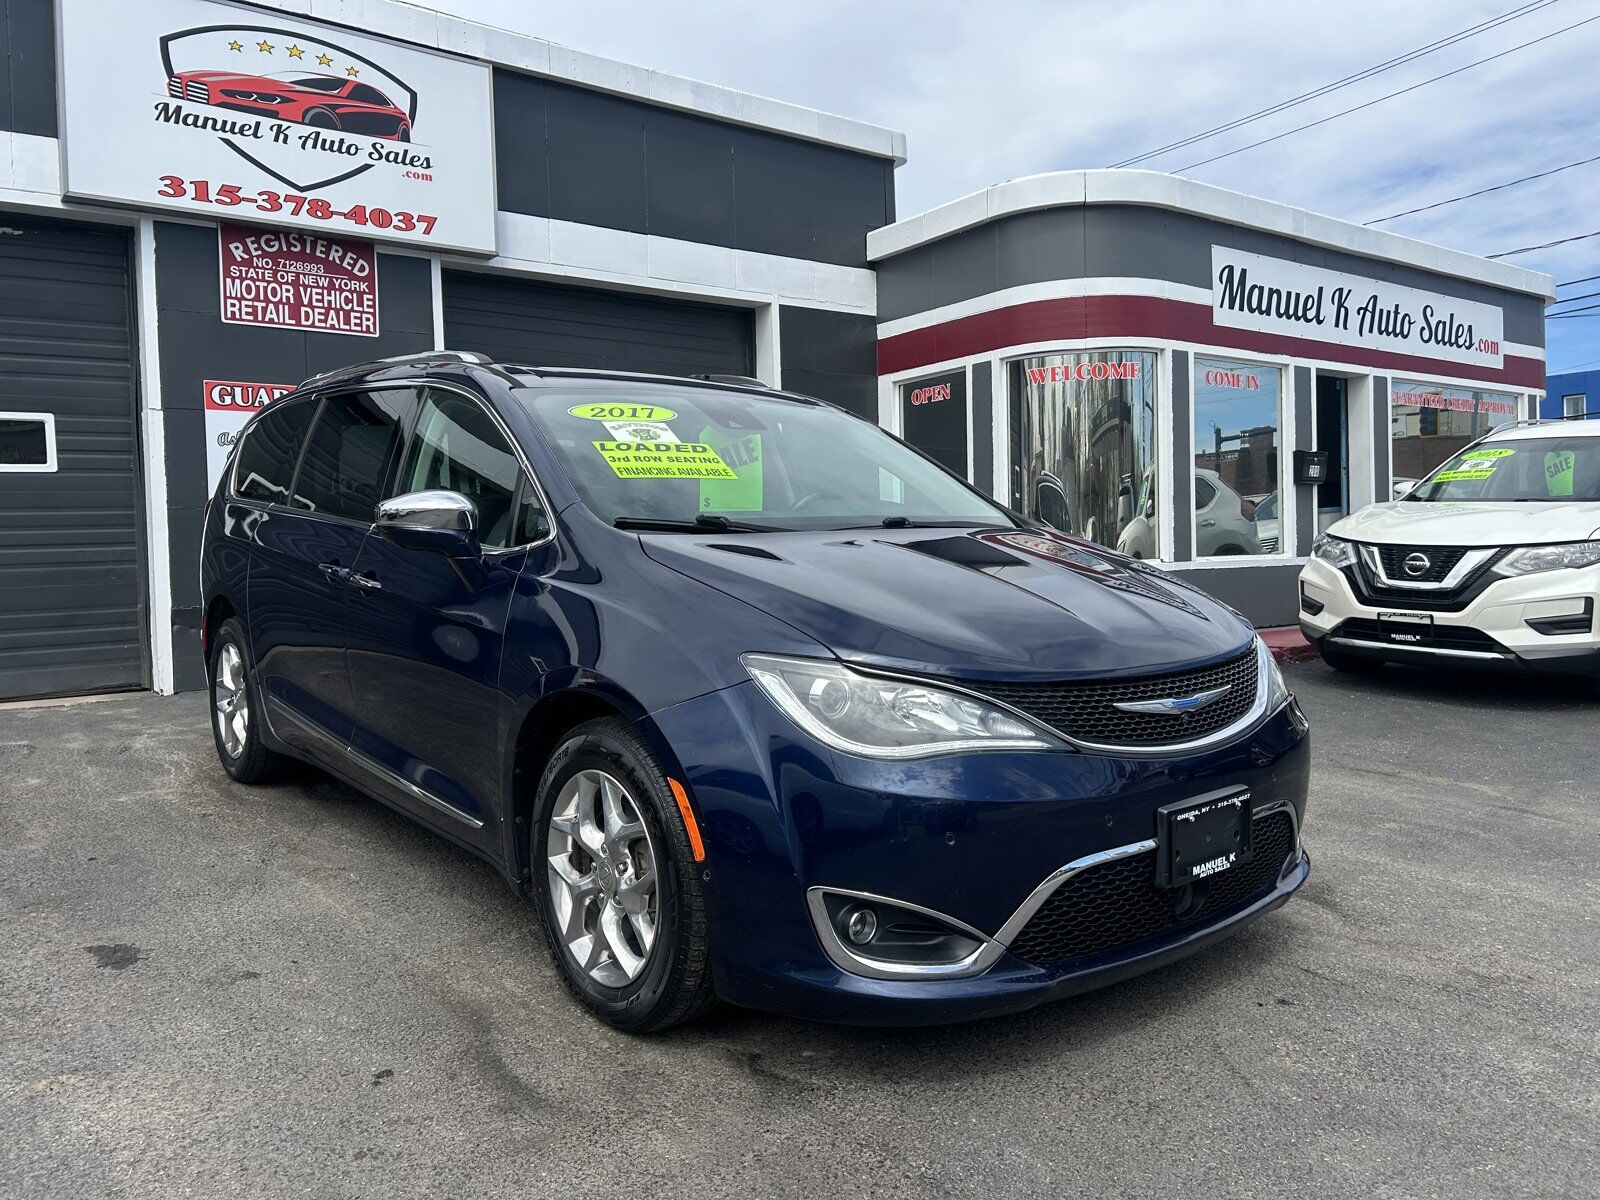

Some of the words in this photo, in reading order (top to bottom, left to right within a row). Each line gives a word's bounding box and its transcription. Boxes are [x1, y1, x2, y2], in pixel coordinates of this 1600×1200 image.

[154, 101, 264, 140] Manuel
[269, 122, 293, 145] K
[298, 130, 363, 157] Auto
[368, 142, 434, 170] Sales
[402, 172, 433, 182] .com
[158, 175, 438, 236] 315-378-4037
[228, 233, 370, 277] REGISTERED
[253, 257, 276, 269] NO.
[277, 258, 325, 274] 7126993
[230, 265, 274, 281] STATE
[277, 271, 296, 283] OF
[299, 274, 329, 287] NEW
[333, 278, 369, 292] YORK
[225, 278, 295, 304] MOTOR
[299, 286, 374, 313] VEHICLE
[1219, 264, 1326, 325] Manuel
[1331, 287, 1352, 331] K
[1357, 294, 1416, 340] Auto
[226, 299, 296, 325] RETAIL
[300, 307, 375, 333] DEALER
[1028, 362, 1141, 385] WELCOME
[1204, 369, 1243, 391] COME
[1245, 375, 1260, 391] IN
[911, 383, 951, 406] OPEN
[590, 406, 655, 419] 2017
[600, 442, 708, 454] LOADED
[608, 455, 631, 463] 3rd
[635, 455, 663, 463] ROW
[667, 456, 720, 464] SEATING
[616, 467, 676, 476] FINANCING
[679, 467, 733, 477] AVAILABLE
[1546, 456, 1572, 479] SALE
[1201, 805, 1211, 813] NY
[1192, 856, 1228, 876] MANUEL
[1229, 852, 1237, 862] K
[1199, 869, 1214, 879] AUTO
[1214, 862, 1231, 874] SALES
